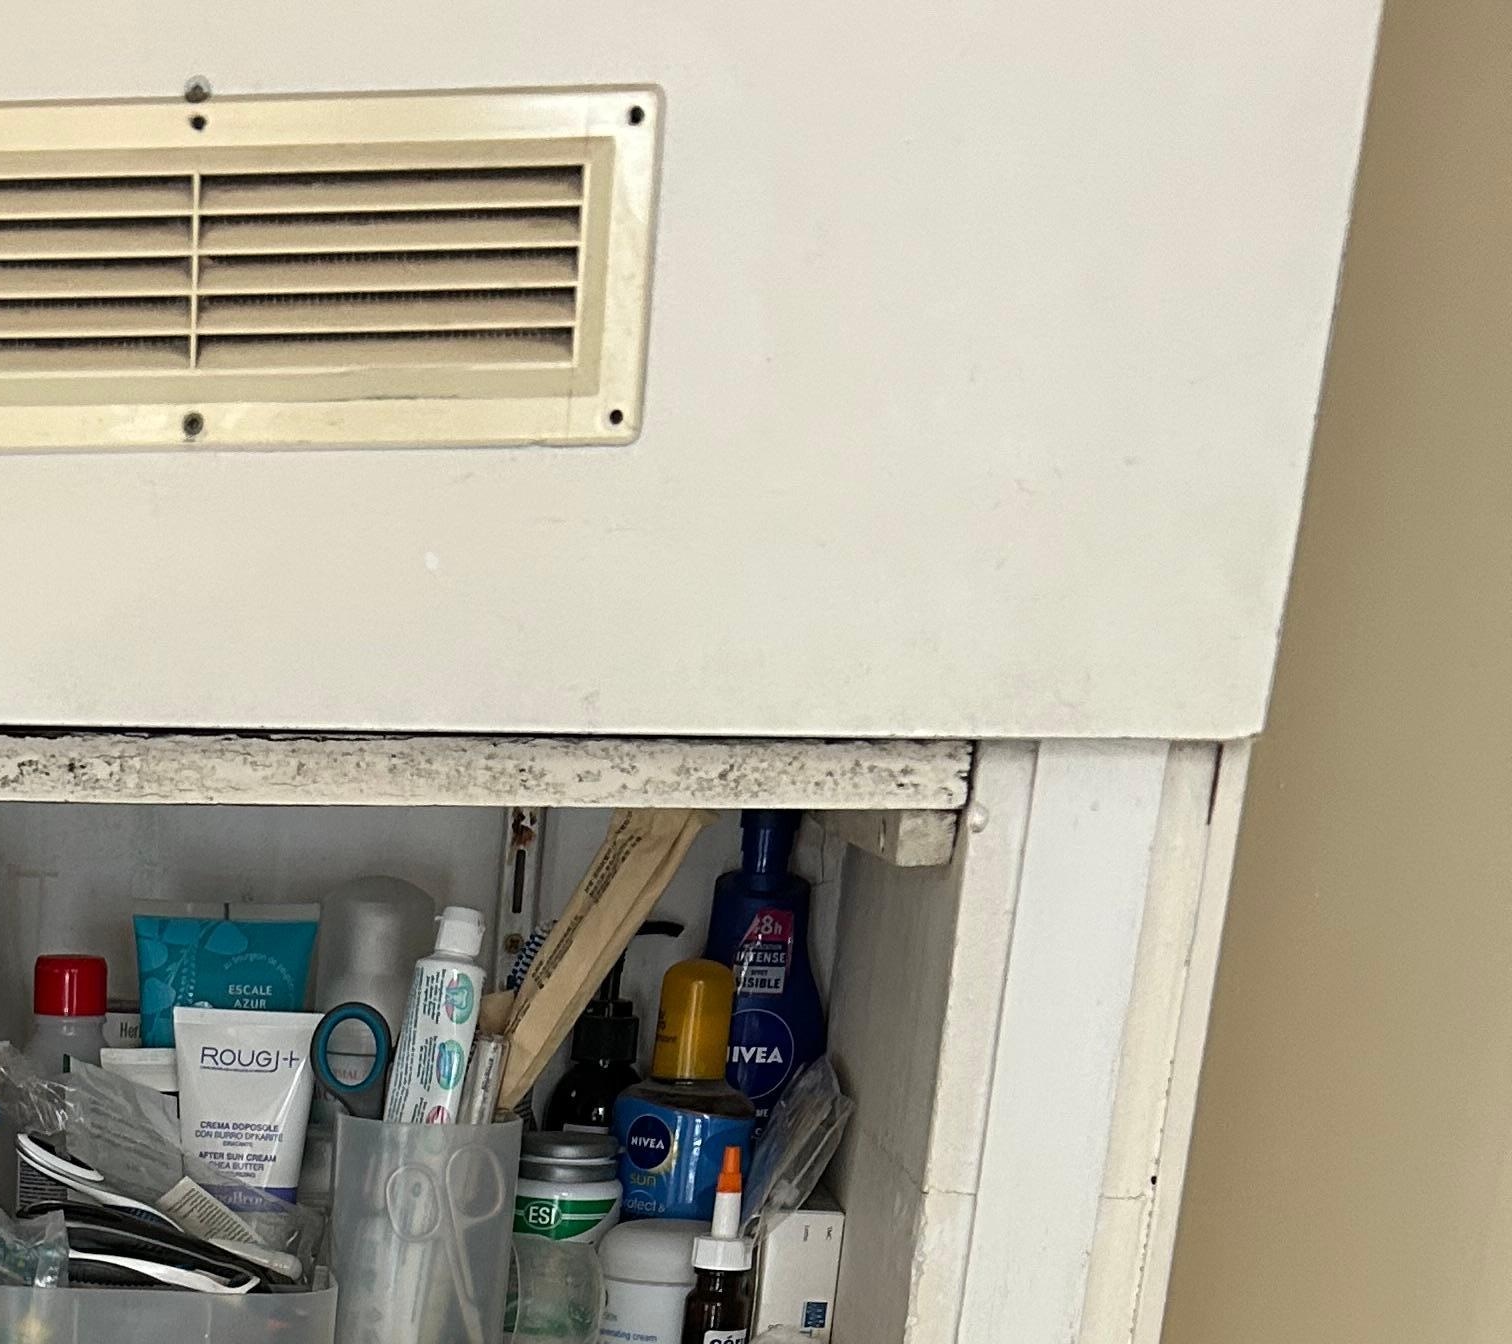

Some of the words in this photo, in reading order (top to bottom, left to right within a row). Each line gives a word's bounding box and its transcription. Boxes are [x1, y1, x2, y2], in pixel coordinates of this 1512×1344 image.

[228, 984, 273, 996] ESCALE
[234, 998, 267, 1009] AZUR
[200, 1121, 230, 1130] CREMA
[232, 1122, 279, 1132] DOPOSOLE
[630, 1137, 665, 1150] NIVEA
[199, 1151, 225, 1160] AFTER
[227, 1152, 244, 1161] SUN
[246, 1153, 277, 1163] CREAM
[528, 1205, 557, 1225] ESI
